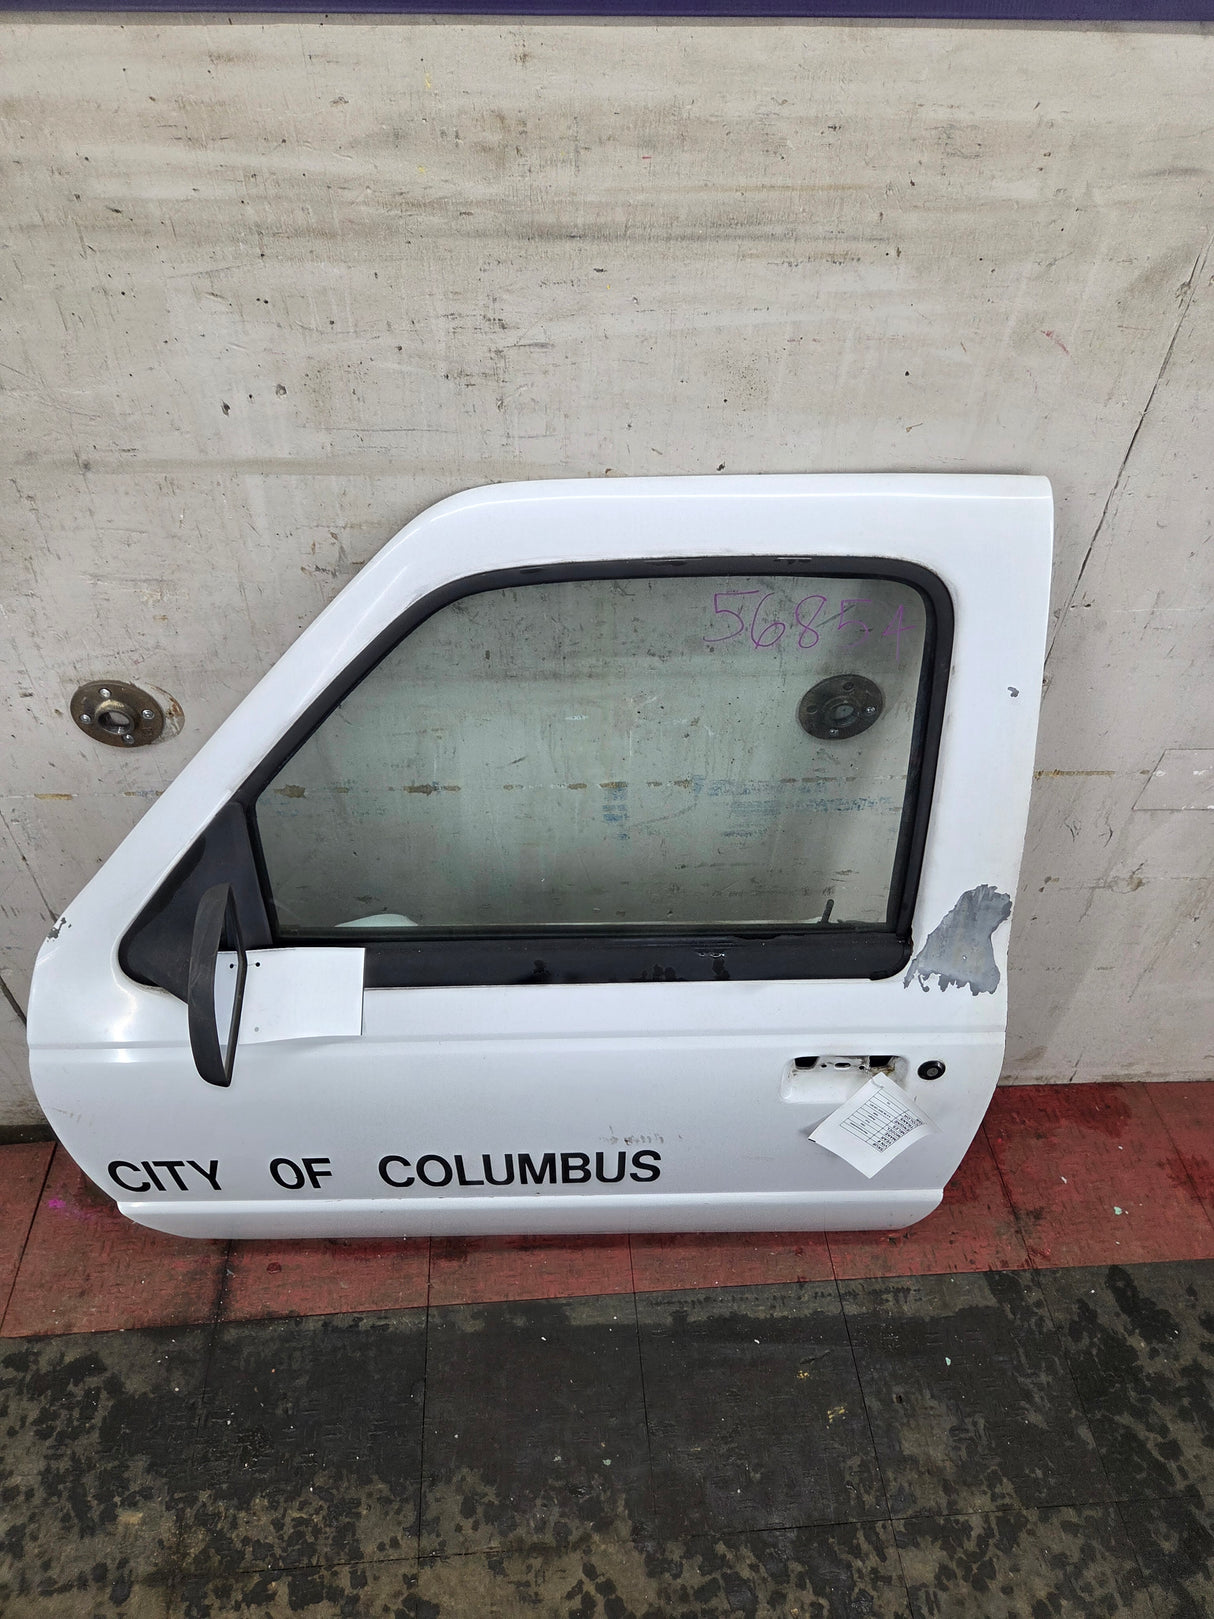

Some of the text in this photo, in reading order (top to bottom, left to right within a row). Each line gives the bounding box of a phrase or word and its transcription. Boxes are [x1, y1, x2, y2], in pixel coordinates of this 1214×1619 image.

[107, 1149, 662, 1193] CITY OF COLUMBUS
